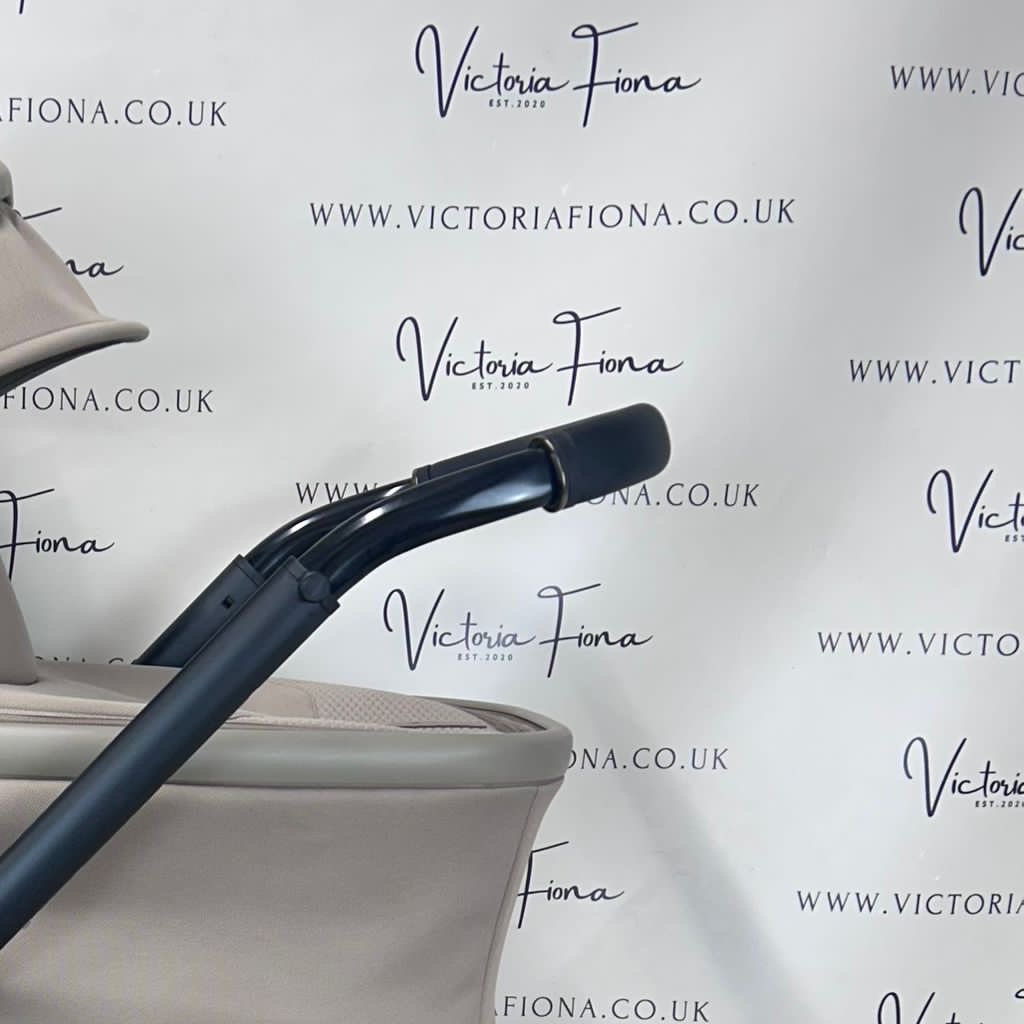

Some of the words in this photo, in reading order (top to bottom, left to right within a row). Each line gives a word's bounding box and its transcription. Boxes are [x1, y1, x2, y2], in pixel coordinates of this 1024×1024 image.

[415, 24, 570, 118] Victoria
[571, 22, 702, 128] Fiona
[310, 199, 795, 230] WWW.VICTORIAFIONA.CO.UK
[396, 316, 553, 402] Victoria
[552, 307, 684, 406] Fiona
[850, 360, 1021, 384] WWW.VICT
[927, 469, 1024, 553] Vict
[383, 588, 536, 671] Victoria
[537, 583, 653, 678] Fiona
[818, 632, 1020, 656] WWW.VICTO
[517, 841, 625, 928] Fiona
[494, 996, 710, 1023] FIONA.CO.UK
